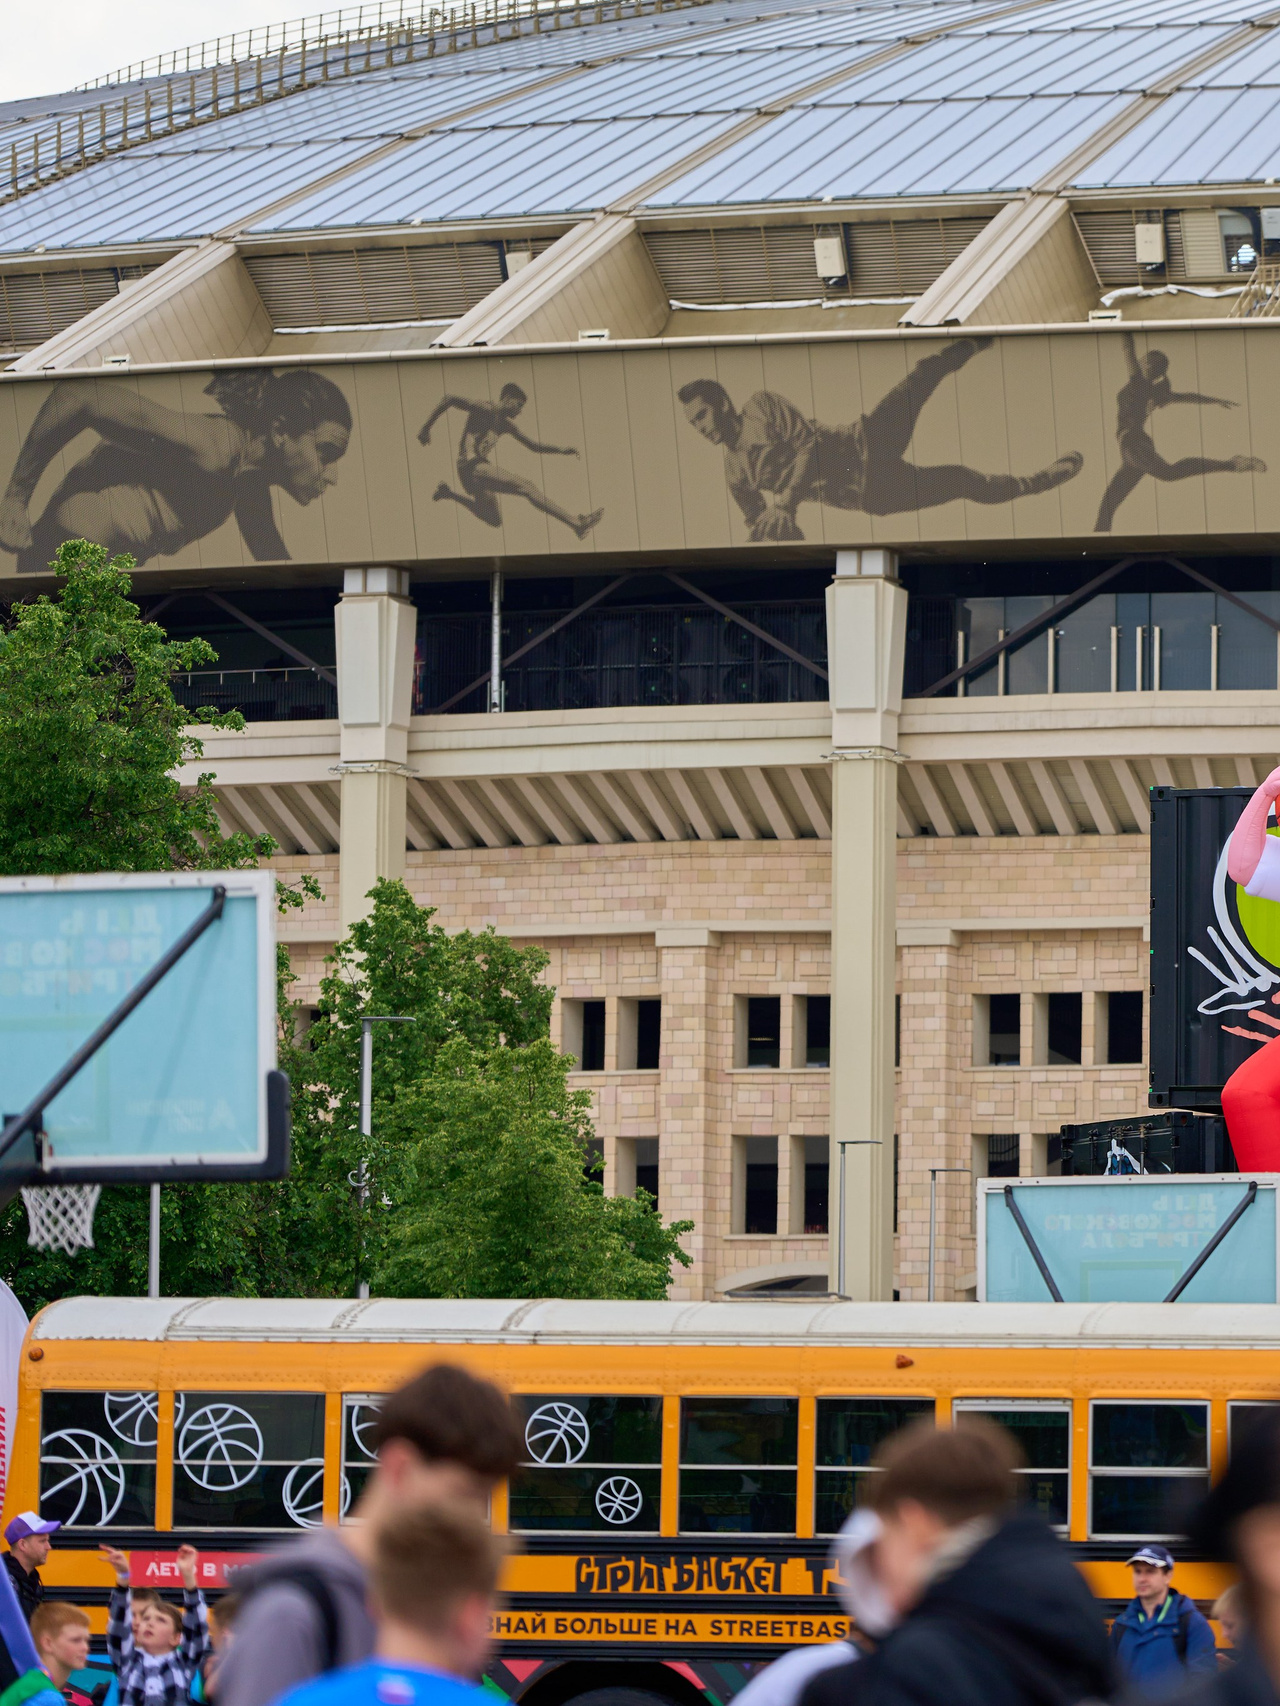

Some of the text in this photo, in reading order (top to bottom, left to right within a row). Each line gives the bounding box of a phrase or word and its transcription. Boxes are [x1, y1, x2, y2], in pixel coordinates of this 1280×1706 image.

[145, 1562, 198, 1577] ЛЕТ
[554, 1617, 657, 1635] БОЛЬШЕ
[665, 1619, 697, 1636] НА
[710, 1620, 853, 1638] STREETBAS
